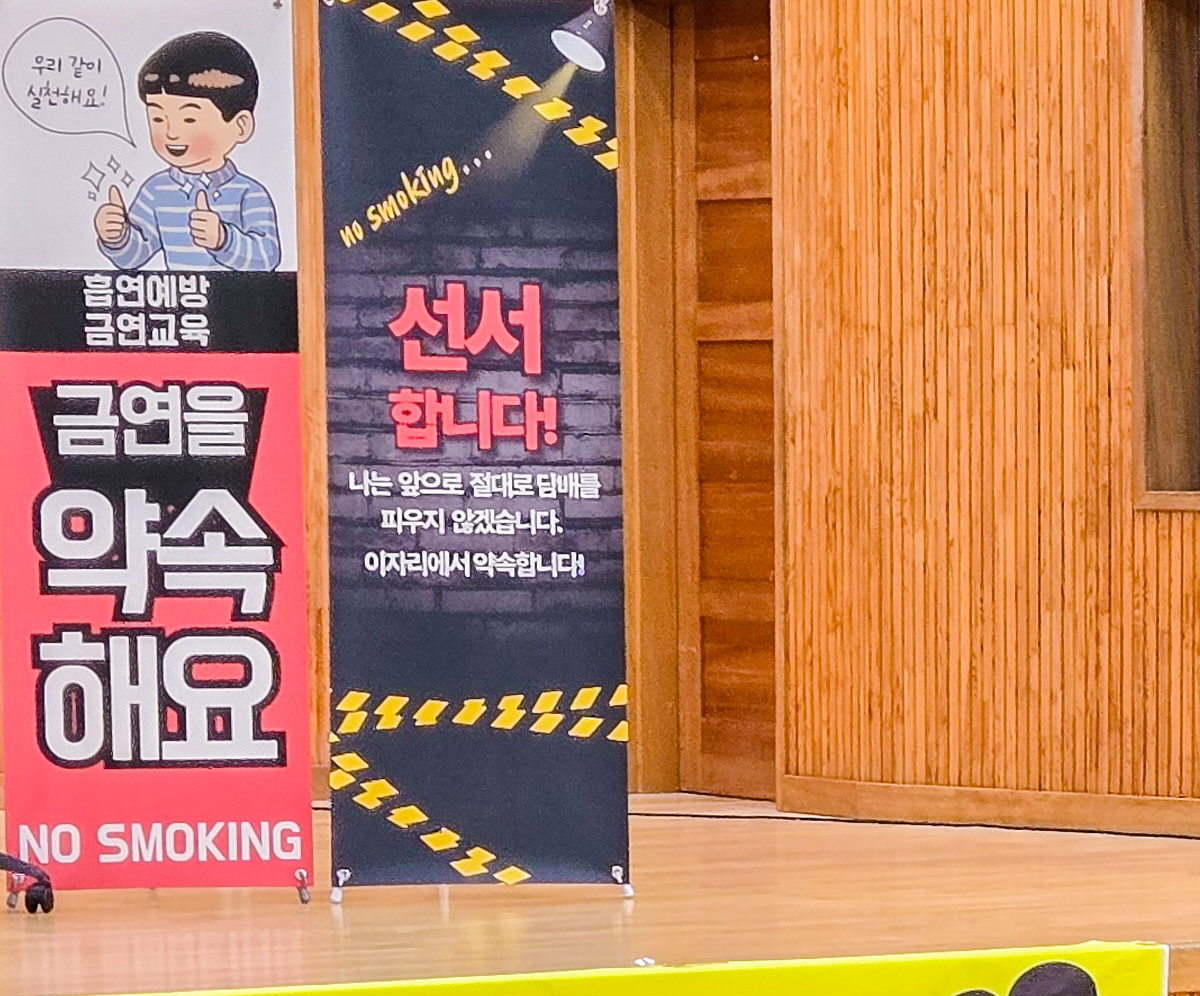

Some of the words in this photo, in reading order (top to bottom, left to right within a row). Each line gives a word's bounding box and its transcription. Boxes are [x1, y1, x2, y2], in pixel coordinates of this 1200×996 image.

[31, 55, 62, 76] 우리
[70, 55, 102, 79] 같이
[27, 81, 108, 109] 실천해요!
[339, 219, 364, 248] no
[83, 273, 211, 309] 흡연예방
[84, 312, 211, 348] 금연교육
[388, 282, 543, 375] 선서
[52, 384, 249, 457] 금연을
[388, 387, 559, 451] 합니다!
[348, 469, 394, 497] 나는
[398, 470, 465, 498] 앞으로
[469, 471, 535, 499] 절대로
[536, 472, 602, 499] 담배를
[380, 507, 446, 534] 피우지
[451, 508, 564, 536] 않겠습니다.
[40, 487, 275, 615] 약속
[364, 550, 470, 577] 이자리에서
[472, 552, 586, 578] 약속합니다!
[39, 631, 280, 762] 해요
[19, 824, 81, 865] NO
[98, 821, 302, 864] SMOKING
